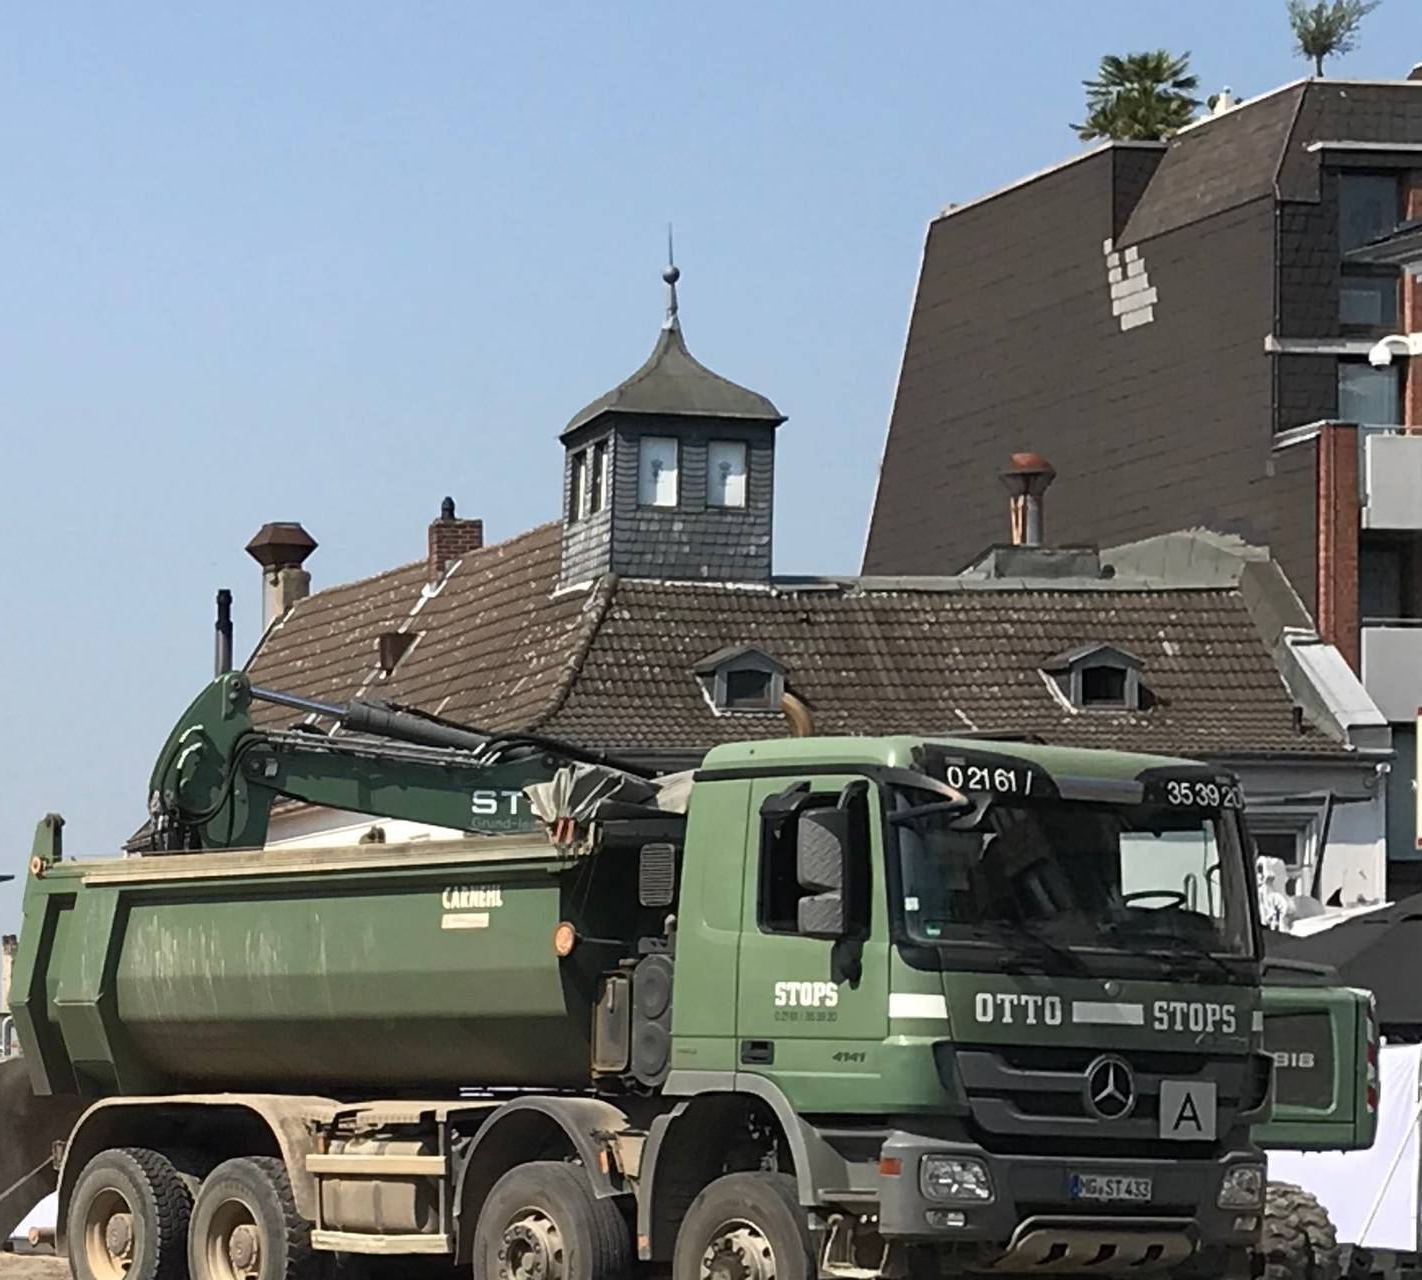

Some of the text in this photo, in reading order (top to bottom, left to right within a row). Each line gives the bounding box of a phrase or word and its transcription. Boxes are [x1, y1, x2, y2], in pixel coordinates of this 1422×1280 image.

[774, 980, 839, 1007] STOPS
[975, 992, 1237, 1034] OTTO STOPS
[1173, 1092, 1203, 1132] A
